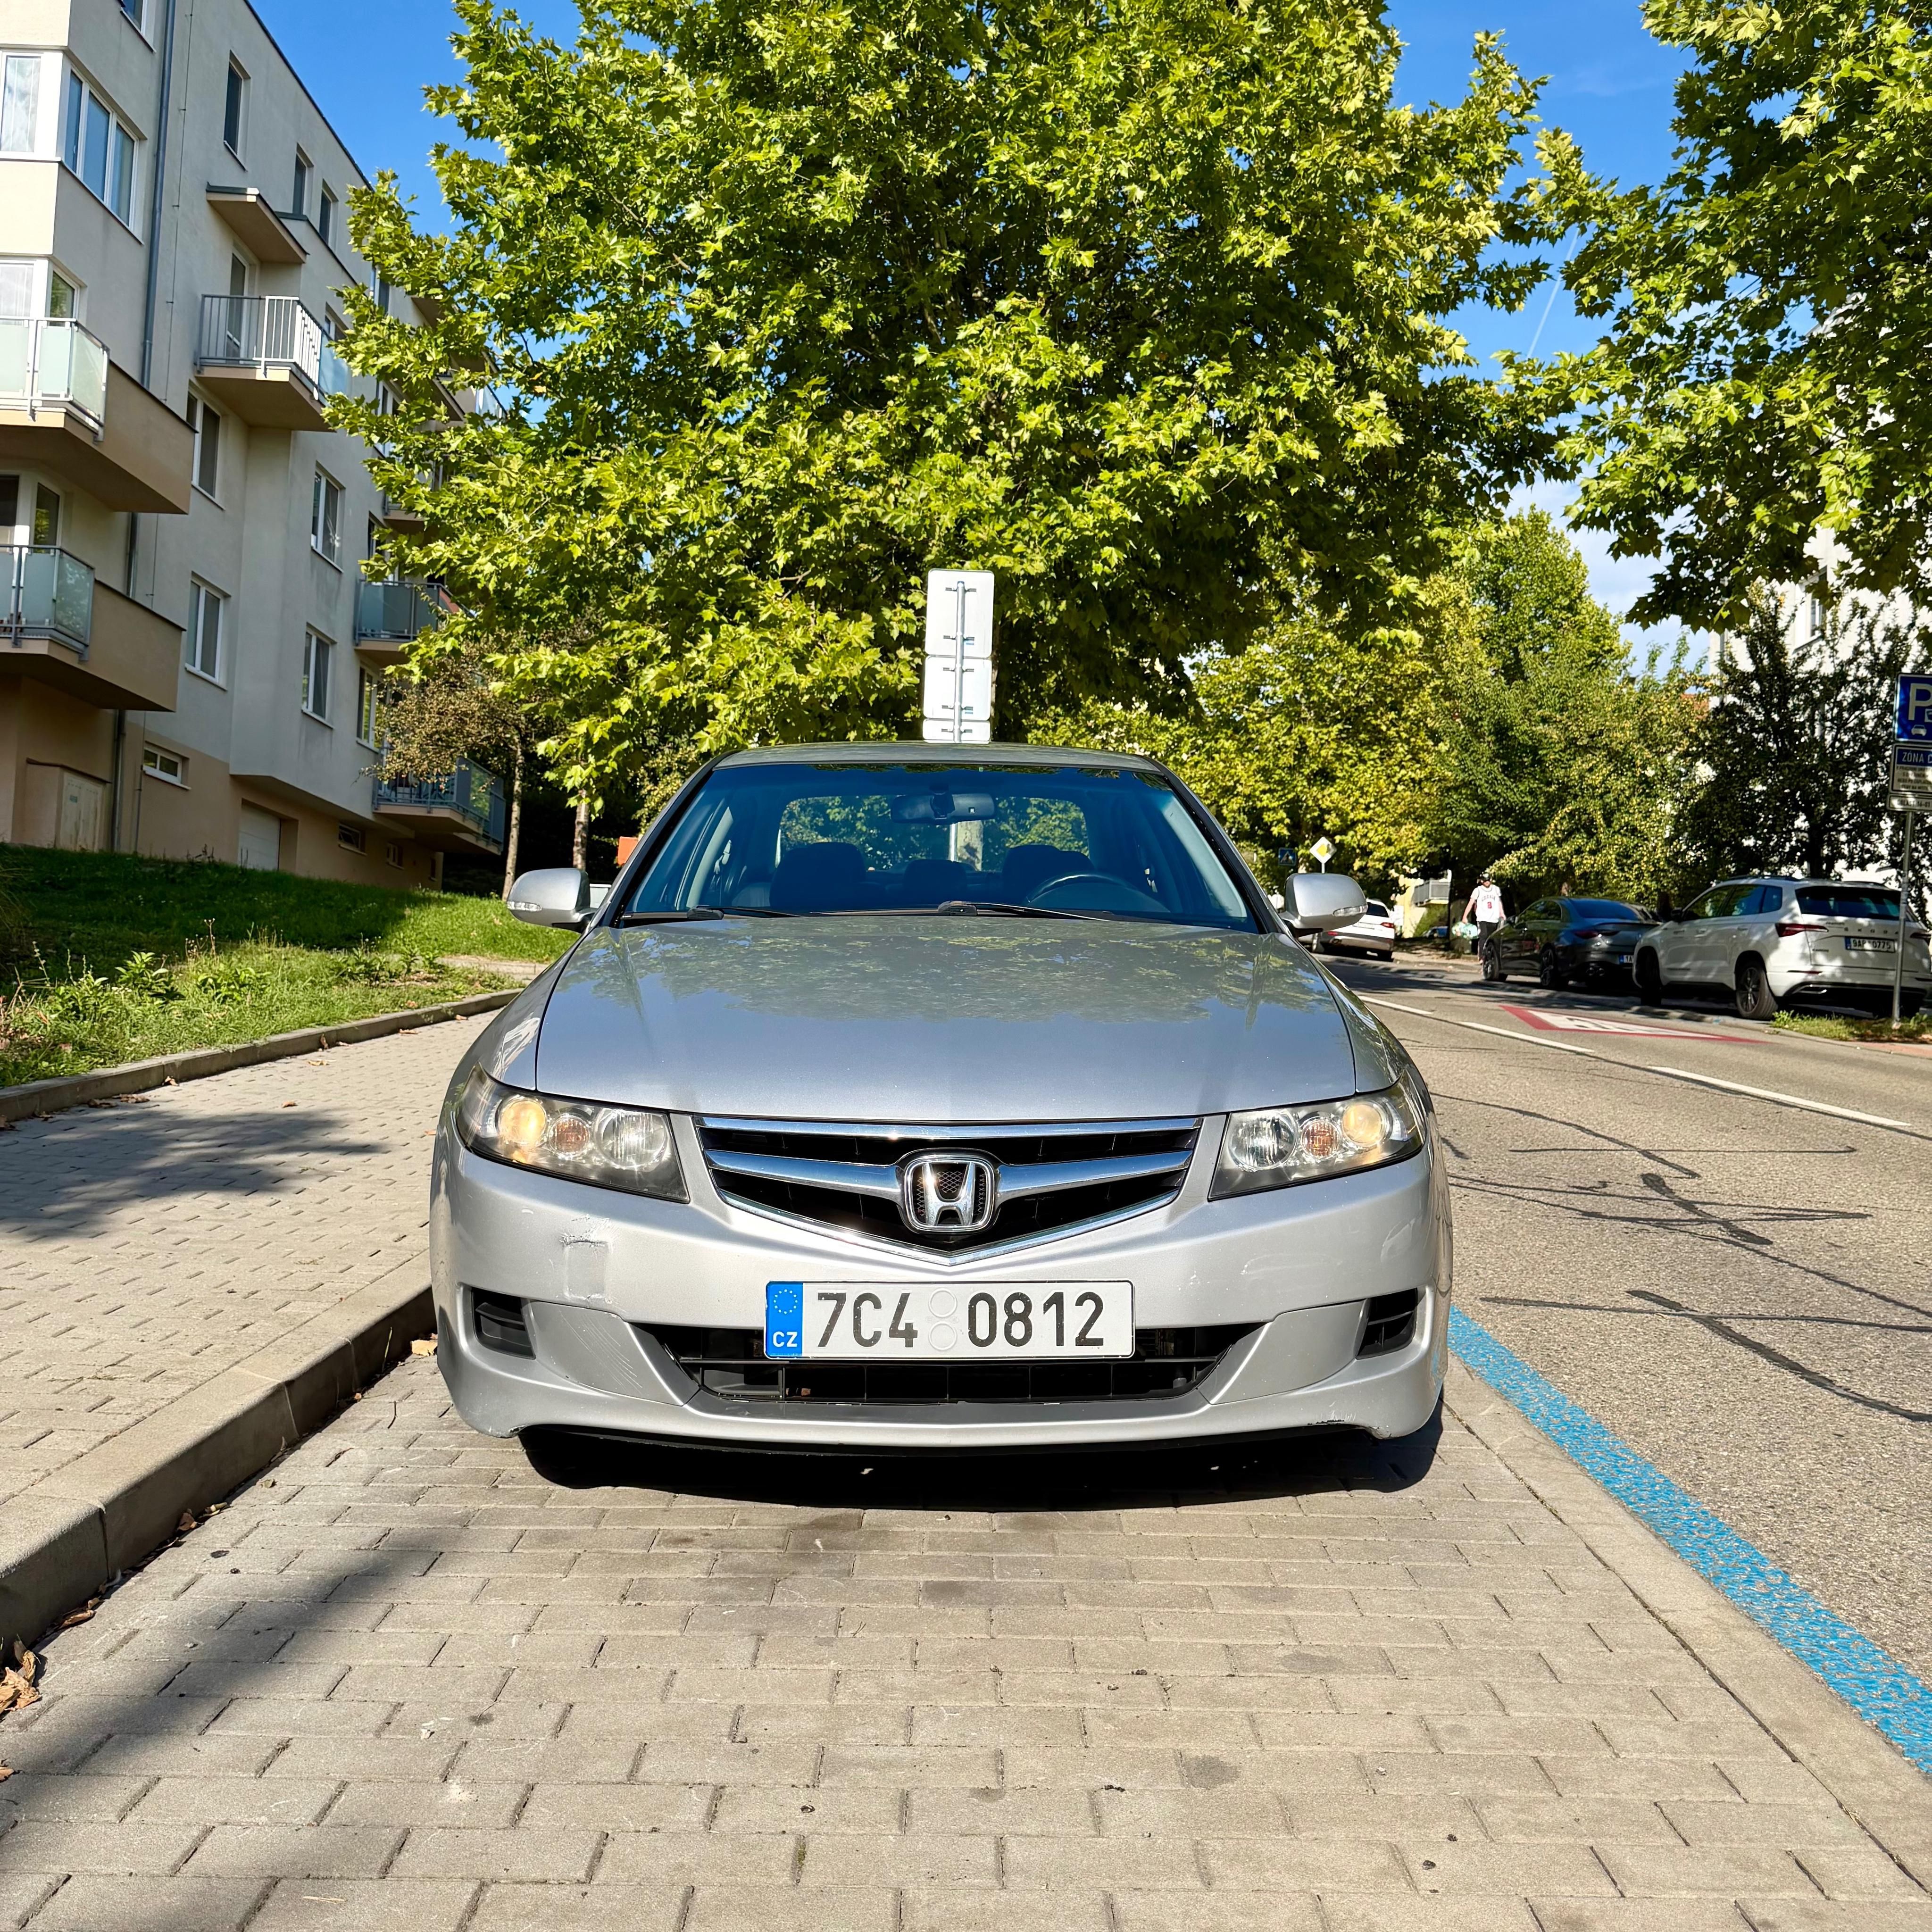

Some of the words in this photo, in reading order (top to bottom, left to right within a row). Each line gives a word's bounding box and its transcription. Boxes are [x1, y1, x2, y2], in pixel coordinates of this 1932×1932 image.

[1902, 750, 1924, 763] ZÓNA
[817, 1292, 918, 1348] 7C4
[968, 1292, 1104, 1348] 0812
[773, 1331, 798, 1348] CZ
